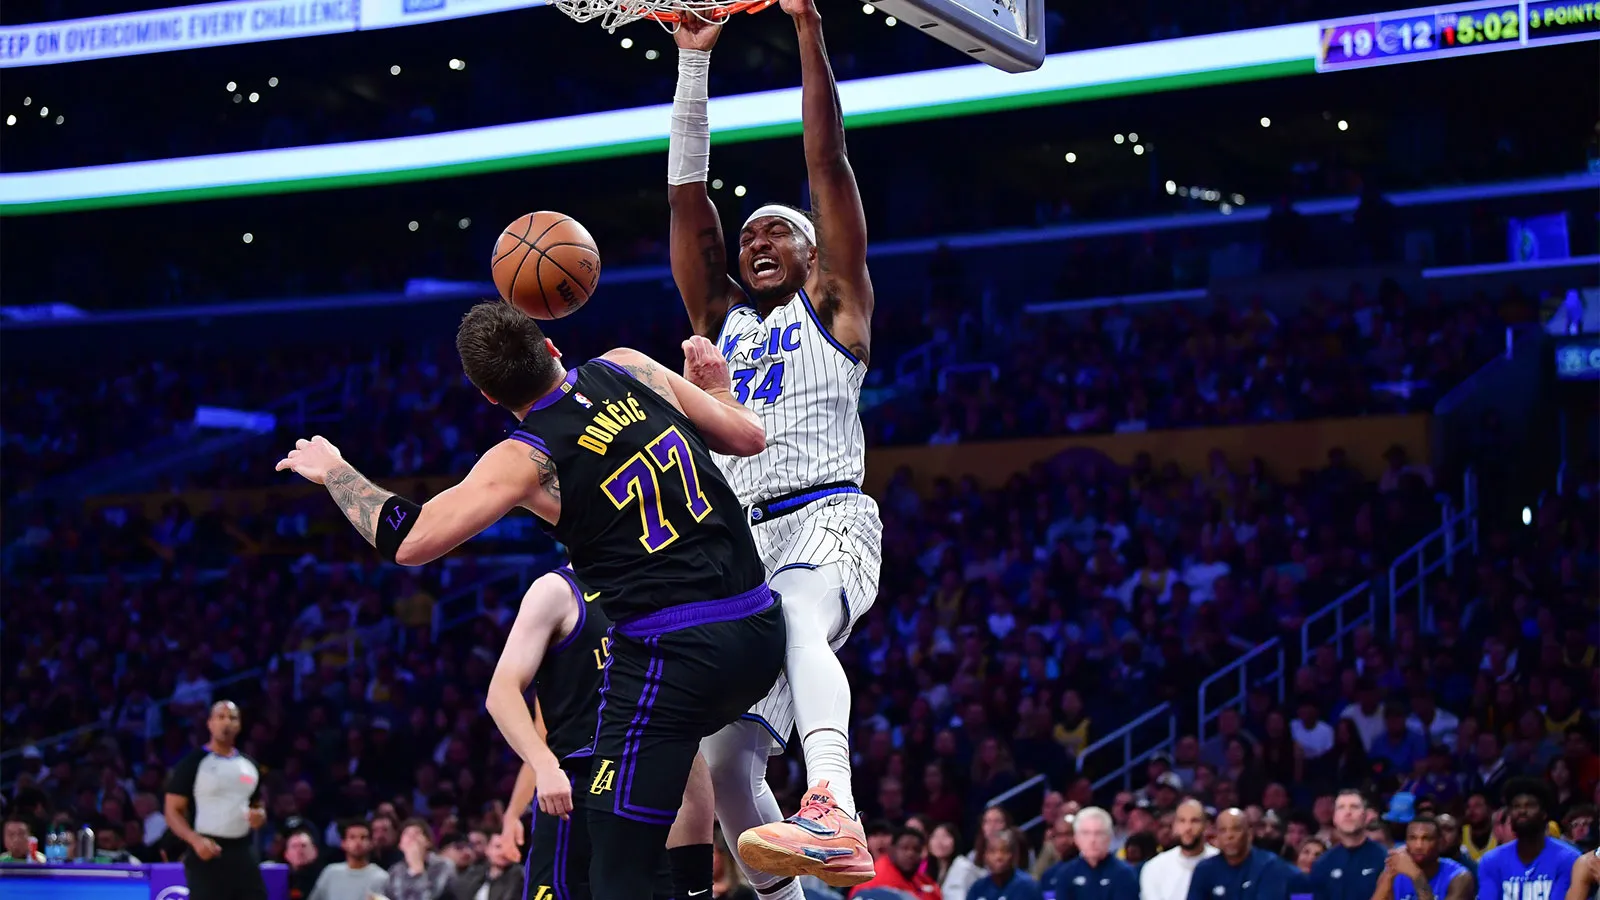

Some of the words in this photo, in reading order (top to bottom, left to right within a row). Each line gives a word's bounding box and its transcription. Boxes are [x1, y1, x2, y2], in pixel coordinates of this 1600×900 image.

[35, 30, 61, 57] ON
[65, 16, 183, 53] OVERCOMING
[188, 9, 247, 40] EVERY
[1399, 21, 1433, 51] 12
[1457, 10, 1519, 45] 5:02
[1530, 9, 1541, 28] 3
[1339, 29, 1374, 58] 19
[732, 361, 785, 405] 34
[577, 392, 647, 456] DONČIĆ
[600, 425, 713, 554] 77
